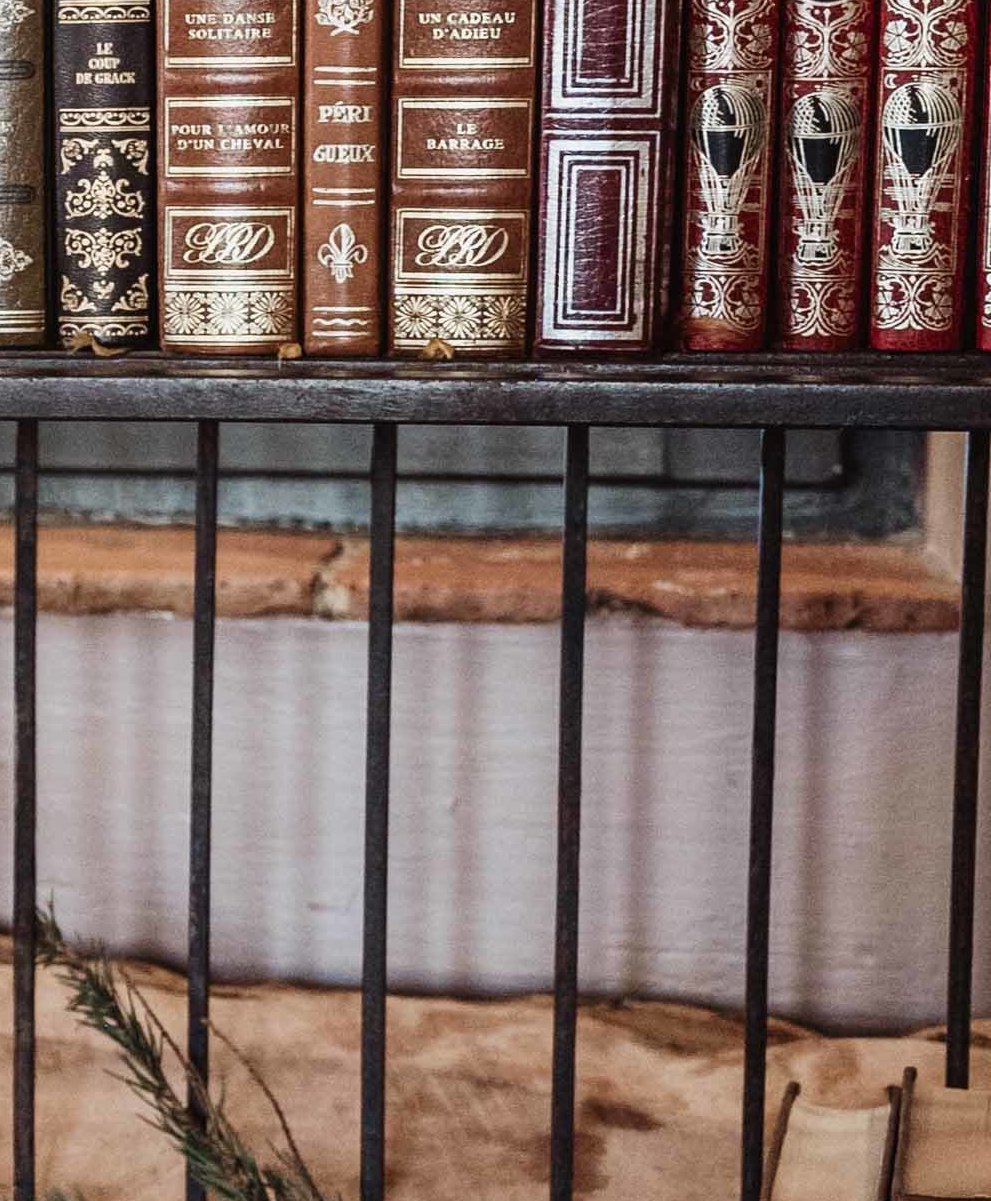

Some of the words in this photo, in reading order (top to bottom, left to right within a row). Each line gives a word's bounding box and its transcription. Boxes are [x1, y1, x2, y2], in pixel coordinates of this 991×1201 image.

[185, 13, 217, 25] UNE
[223, 12, 276, 24] DANSE
[419, 13, 441, 25] UN
[447, 12, 516, 25] CADEAU
[188, 28, 273, 41] SOLITAIRE
[433, 28, 501, 40] D'ADIEU
[96, 42, 113, 55] LE
[88, 57, 120, 70] COUP
[75, 72, 93, 85] DE
[318, 101, 374, 124] PÉRI
[171, 124, 212, 136] POUR
[456, 124, 478, 135] LE
[177, 139, 214, 150] D'UN
[220, 138, 284, 150] CHEVAL
[427, 139, 505, 150] BARRAGE
[313, 144, 376, 164] GUEUX
